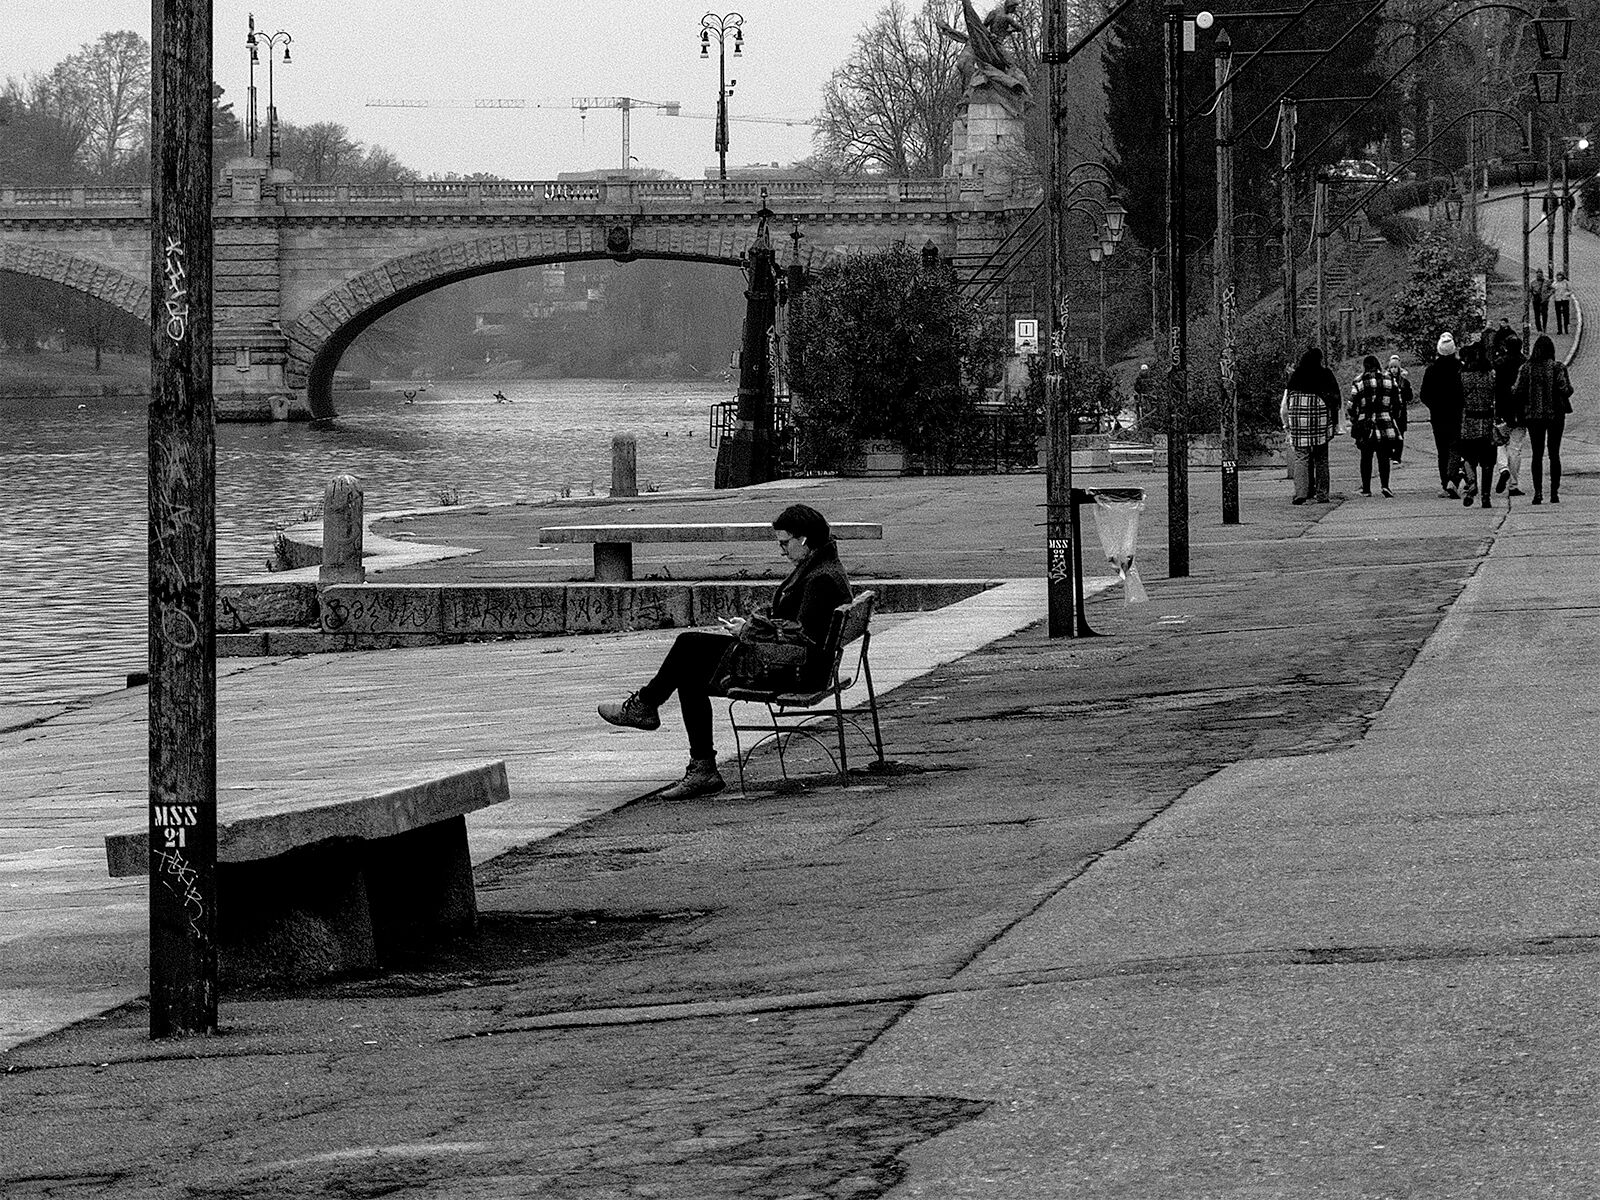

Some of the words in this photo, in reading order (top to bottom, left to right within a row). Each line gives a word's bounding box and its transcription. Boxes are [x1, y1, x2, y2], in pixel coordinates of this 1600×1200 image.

[1049, 539, 1068, 548] MSS
[154, 805, 198, 826] MSS
[164, 827, 186, 848] 21
